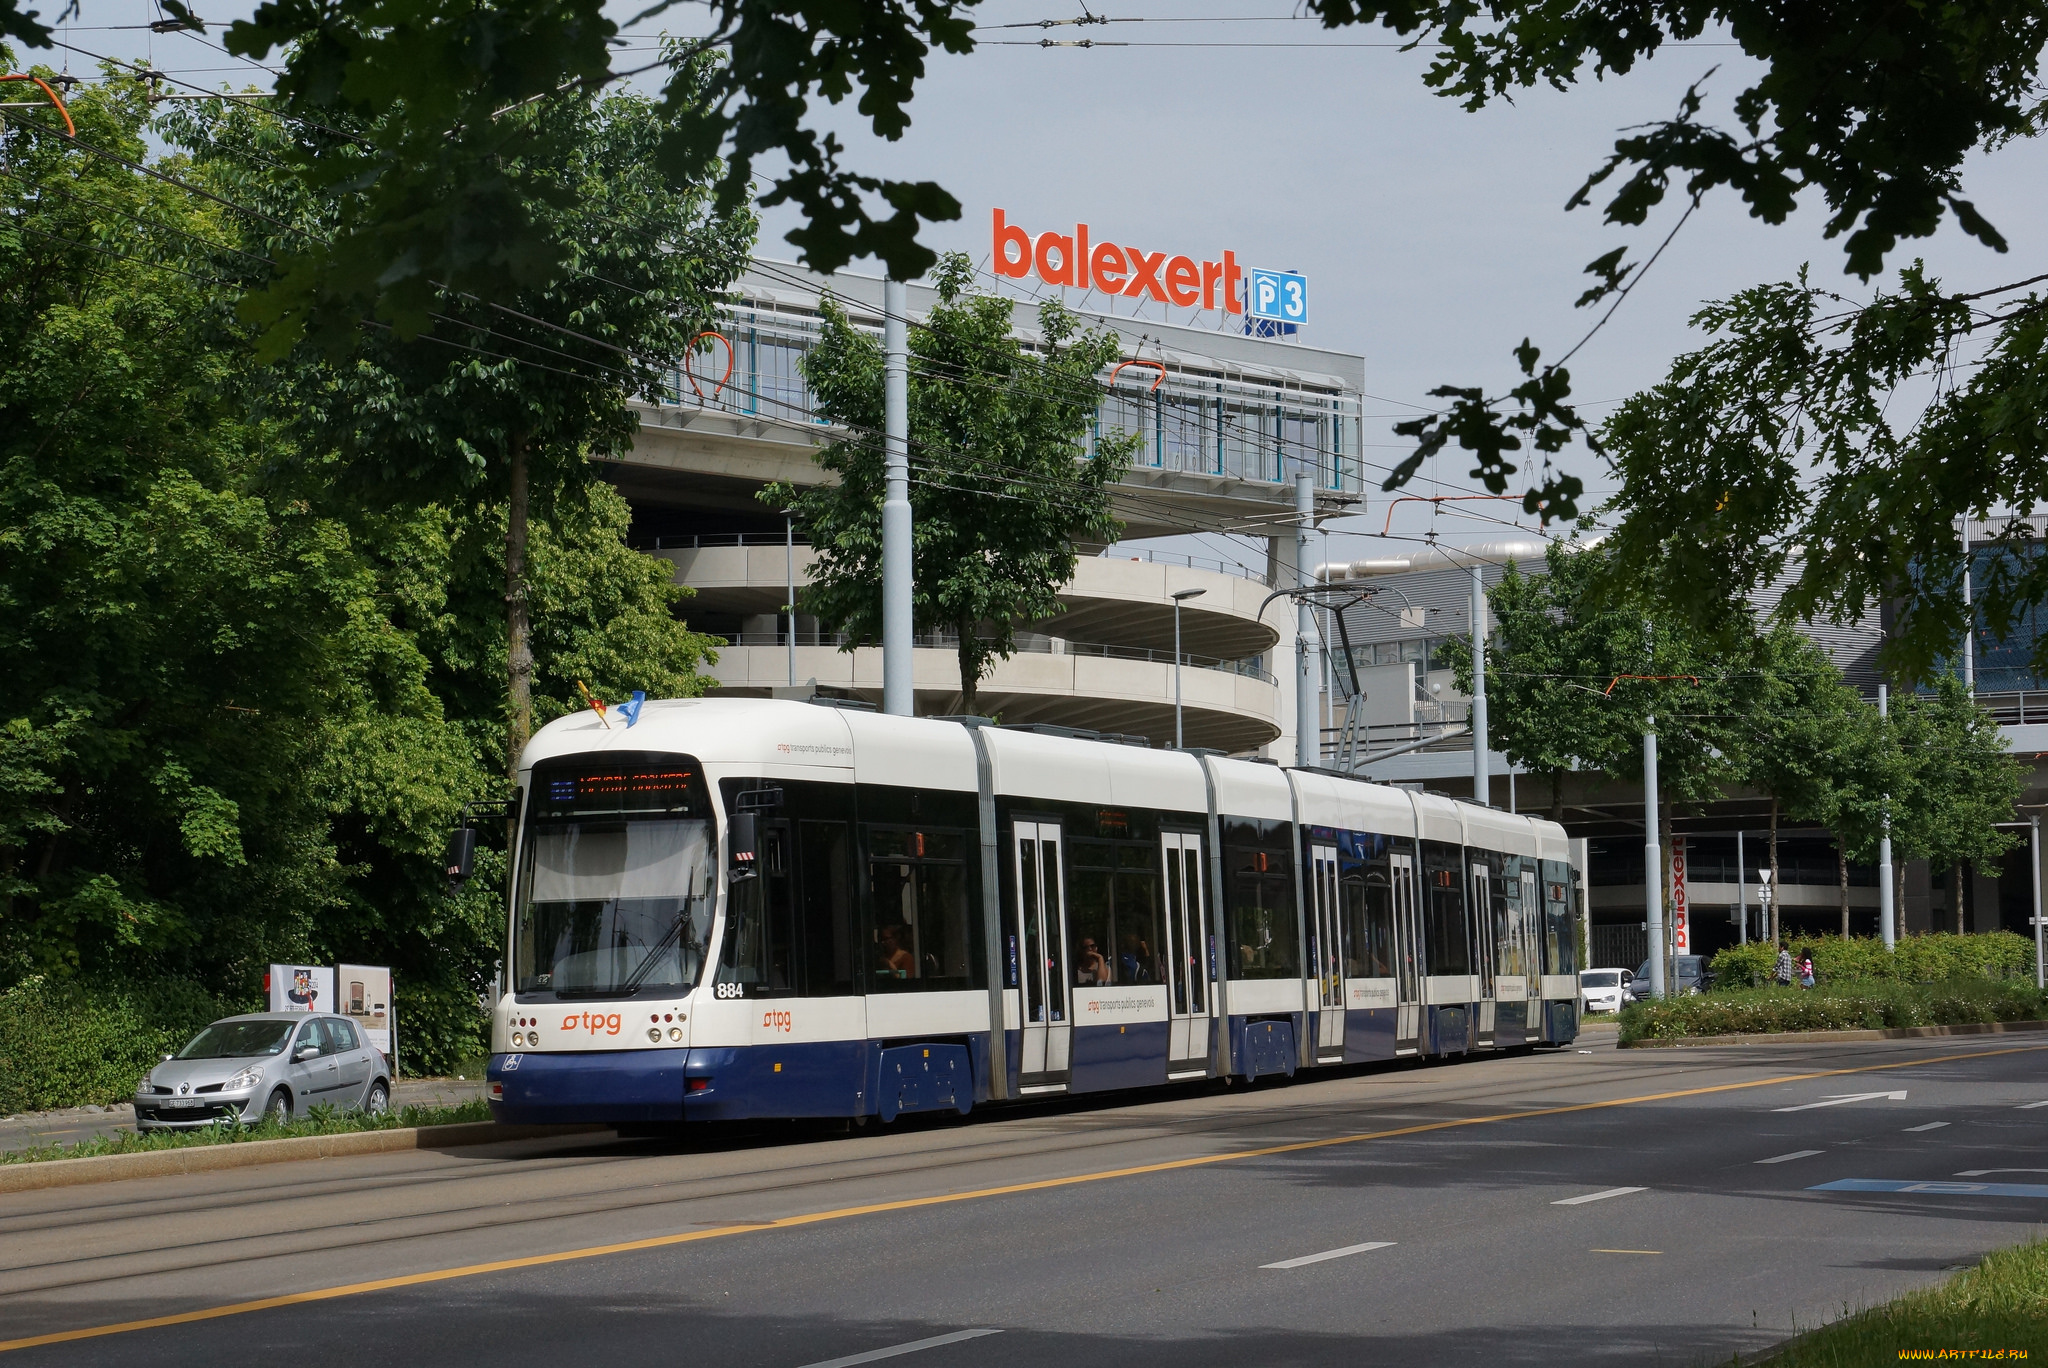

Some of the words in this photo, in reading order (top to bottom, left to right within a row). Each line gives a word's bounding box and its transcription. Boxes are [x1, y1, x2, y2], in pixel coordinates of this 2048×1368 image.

[992, 207, 1242, 315] balexert
[1259, 283, 1276, 313] P
[1284, 280, 1304, 317] 3
[716, 982, 744, 998] 884
